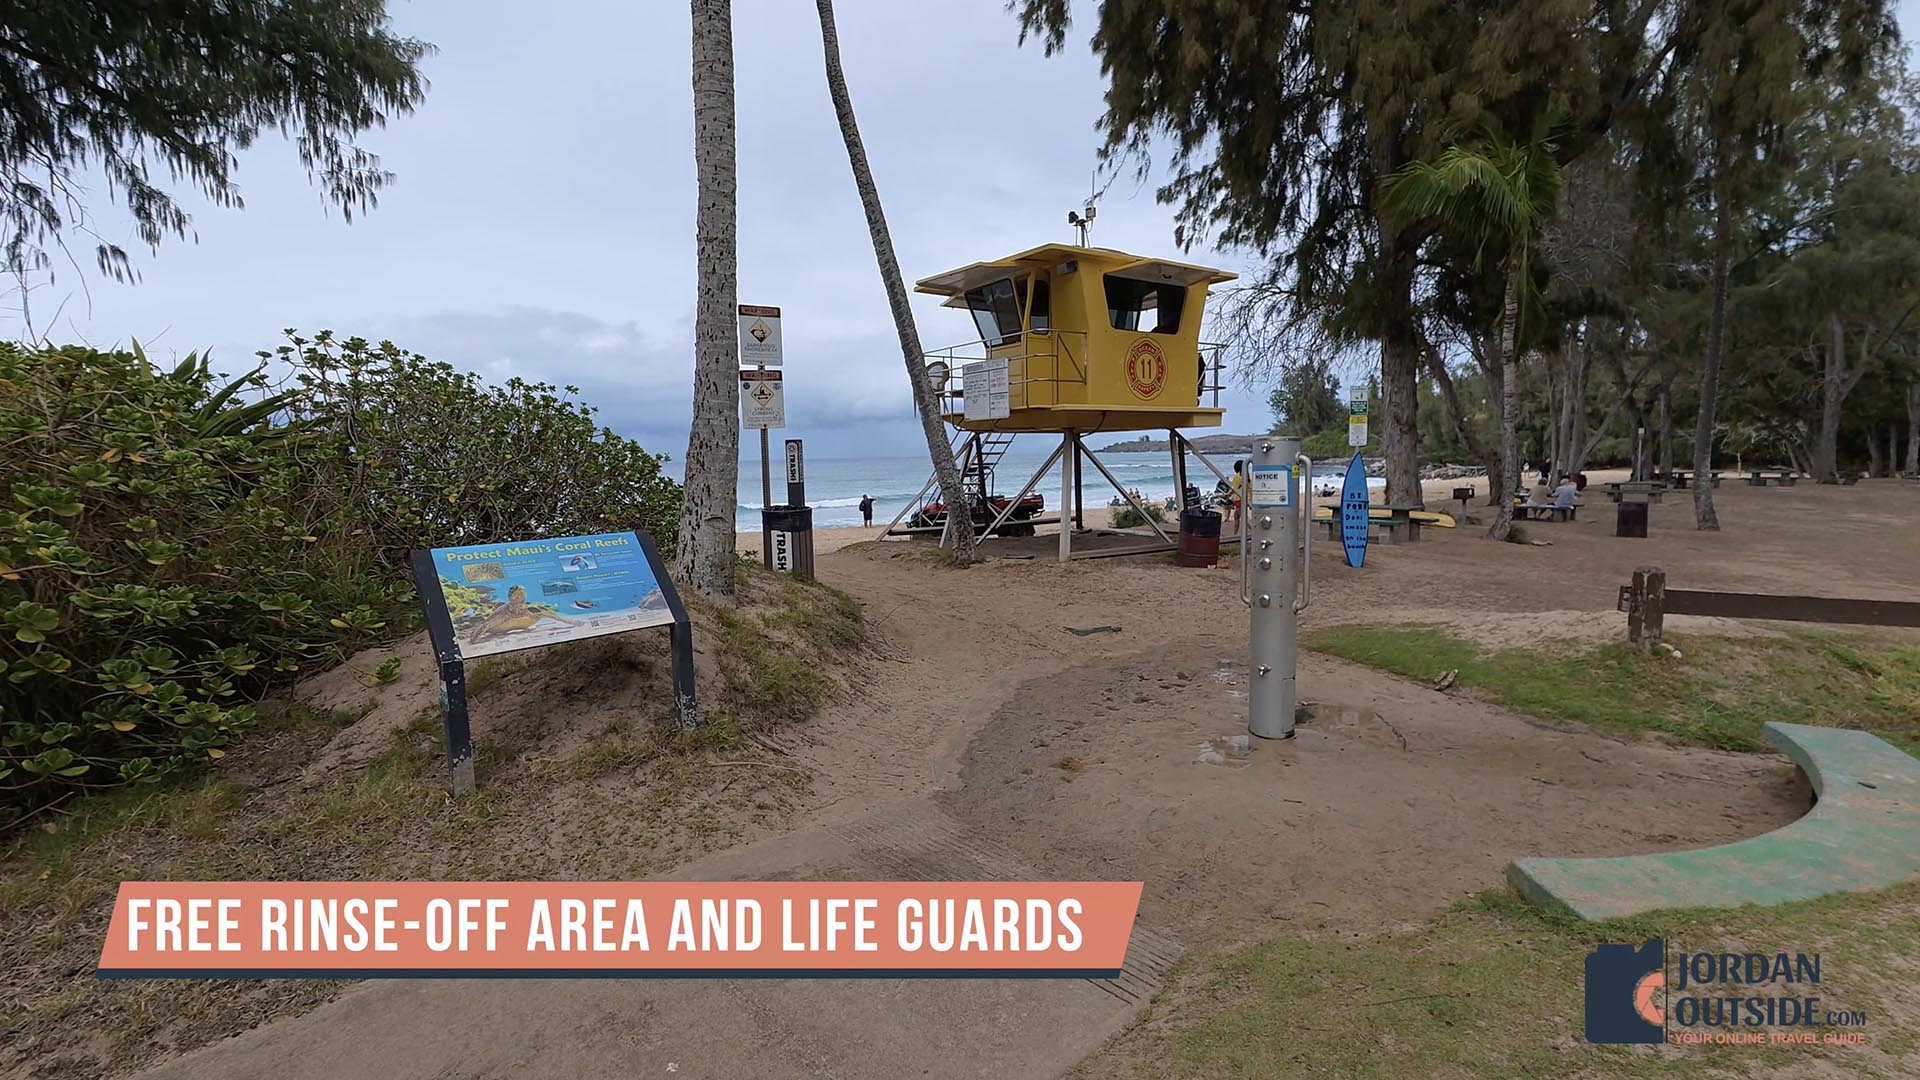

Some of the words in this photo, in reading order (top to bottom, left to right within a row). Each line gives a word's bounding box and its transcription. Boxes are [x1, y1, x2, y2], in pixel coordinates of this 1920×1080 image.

[1141, 359, 1152, 379] 11
[446, 550, 502, 562] Protect
[506, 543, 552, 557] Maui's
[555, 540, 592, 552] Coral
[594, 536, 629, 548] Reefs
[776, 533, 787, 570] TRASH
